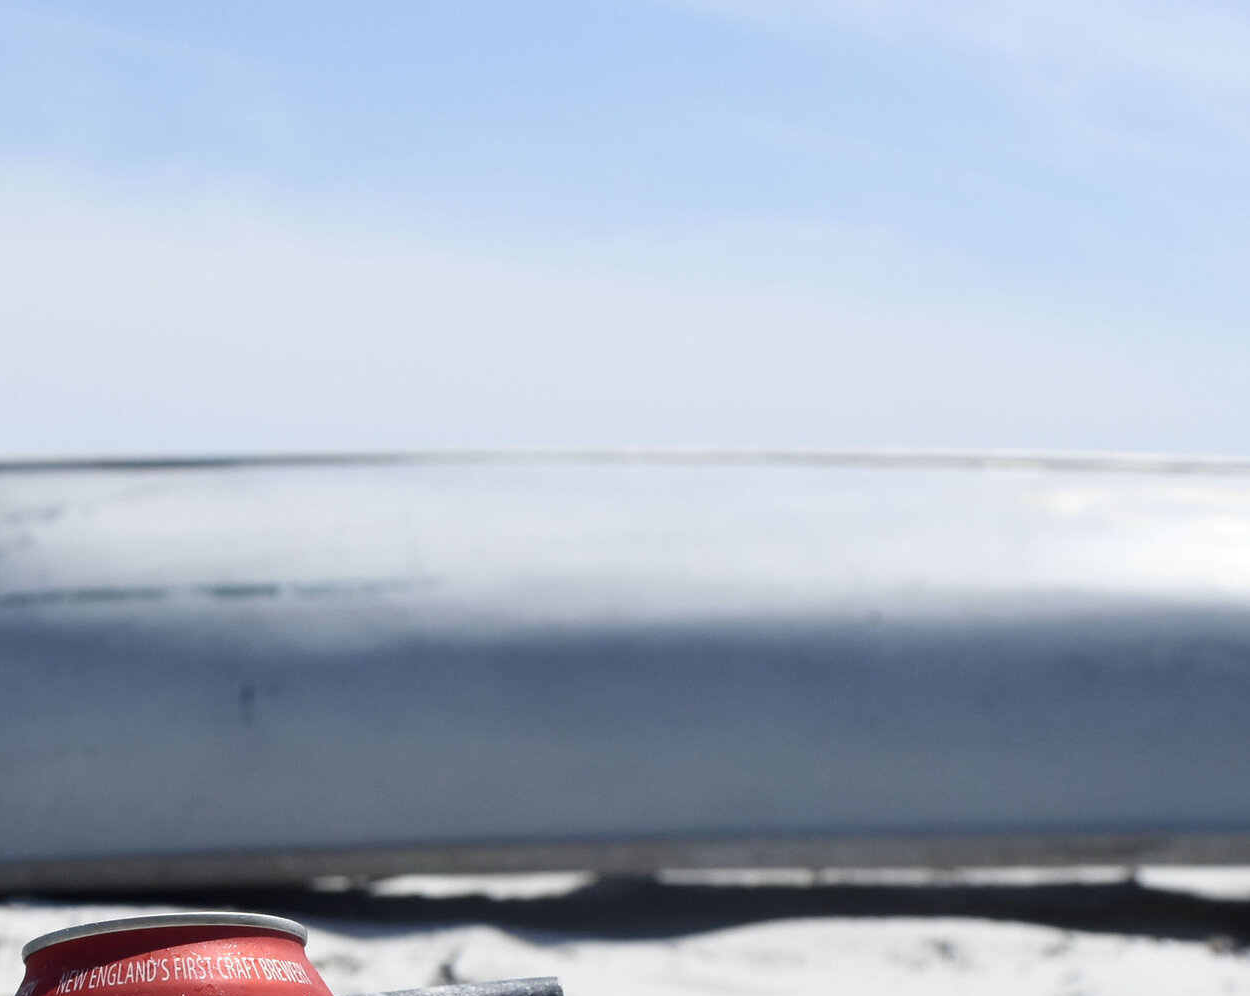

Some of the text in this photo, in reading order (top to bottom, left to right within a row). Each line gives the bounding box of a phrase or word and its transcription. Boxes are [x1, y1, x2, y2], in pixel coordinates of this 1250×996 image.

[56, 955, 312, 995] NEW ENGLAND'S FIRST CRAFT BREWERY
